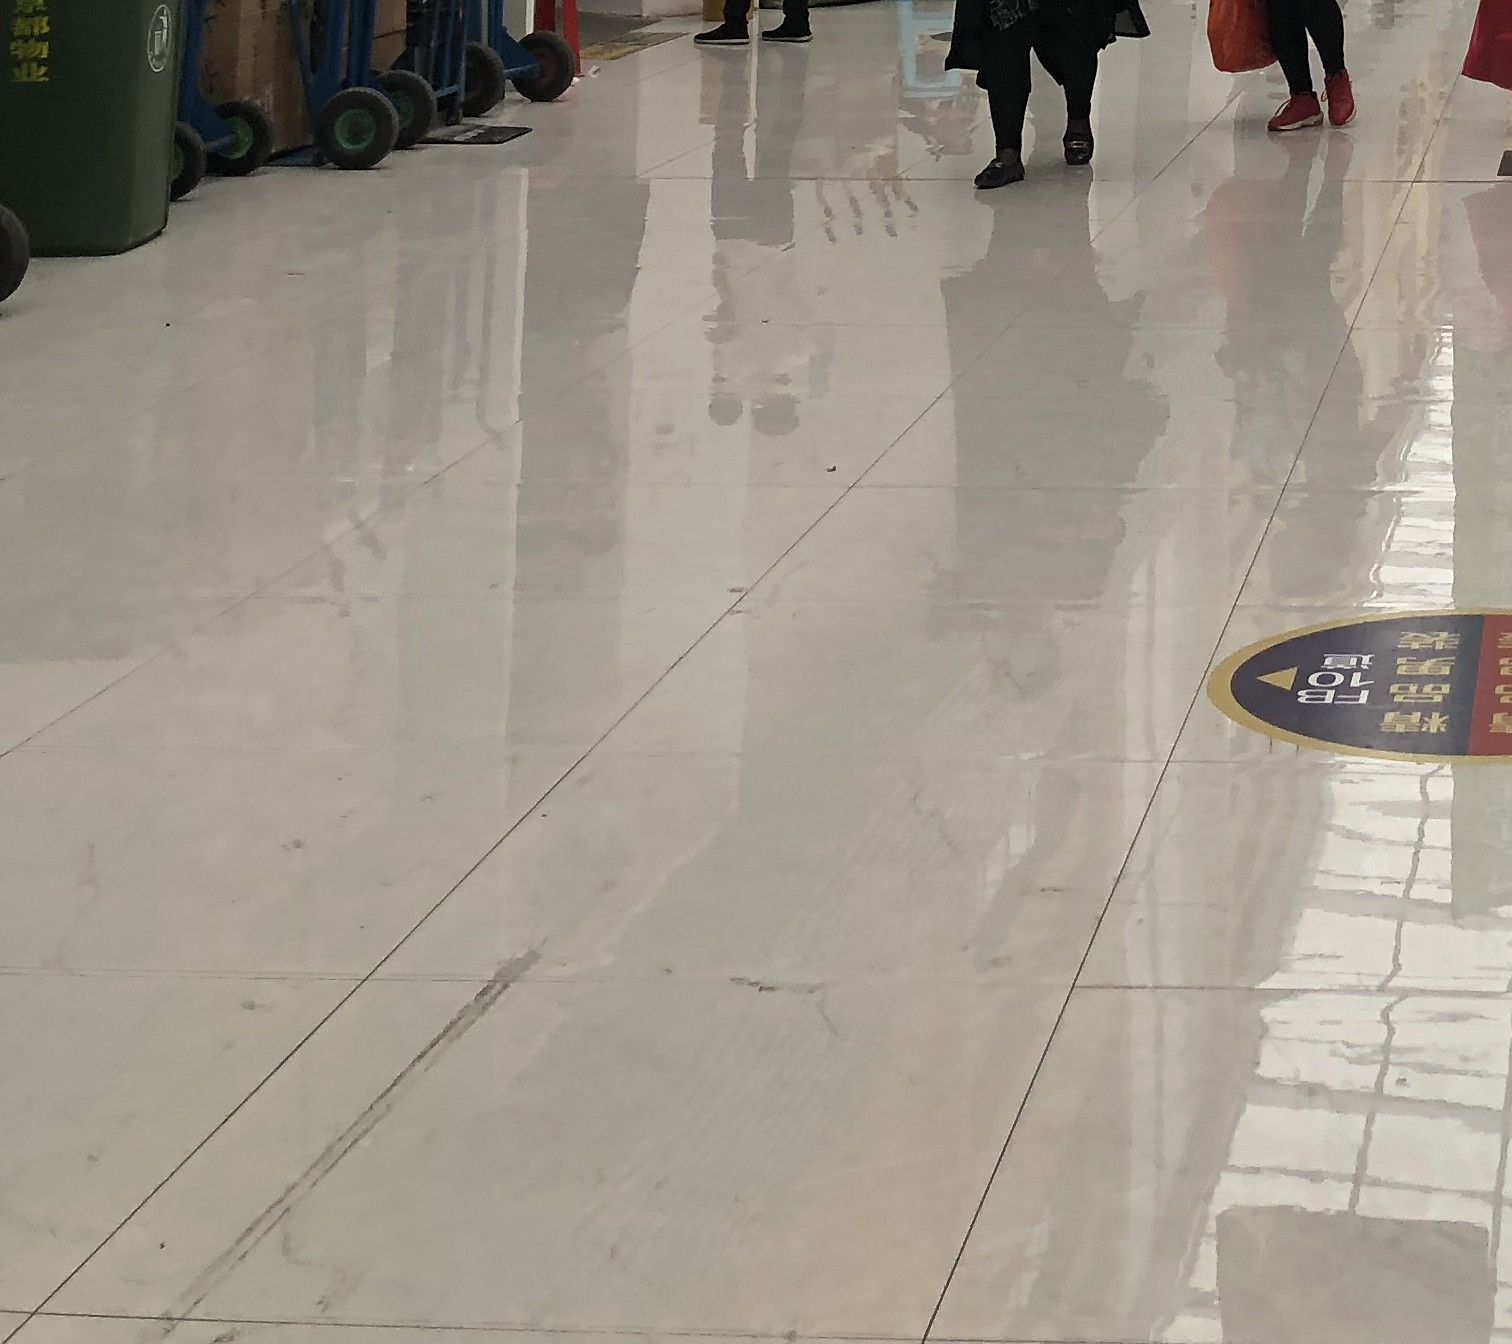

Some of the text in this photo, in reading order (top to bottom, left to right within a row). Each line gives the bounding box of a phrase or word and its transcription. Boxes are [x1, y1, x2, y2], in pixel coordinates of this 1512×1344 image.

[1322, 653, 1375, 670] 道
[1307, 670, 1374, 688] 10
[1379, 630, 1461, 735] 精品男装
[1296, 688, 1370, 704] FB
